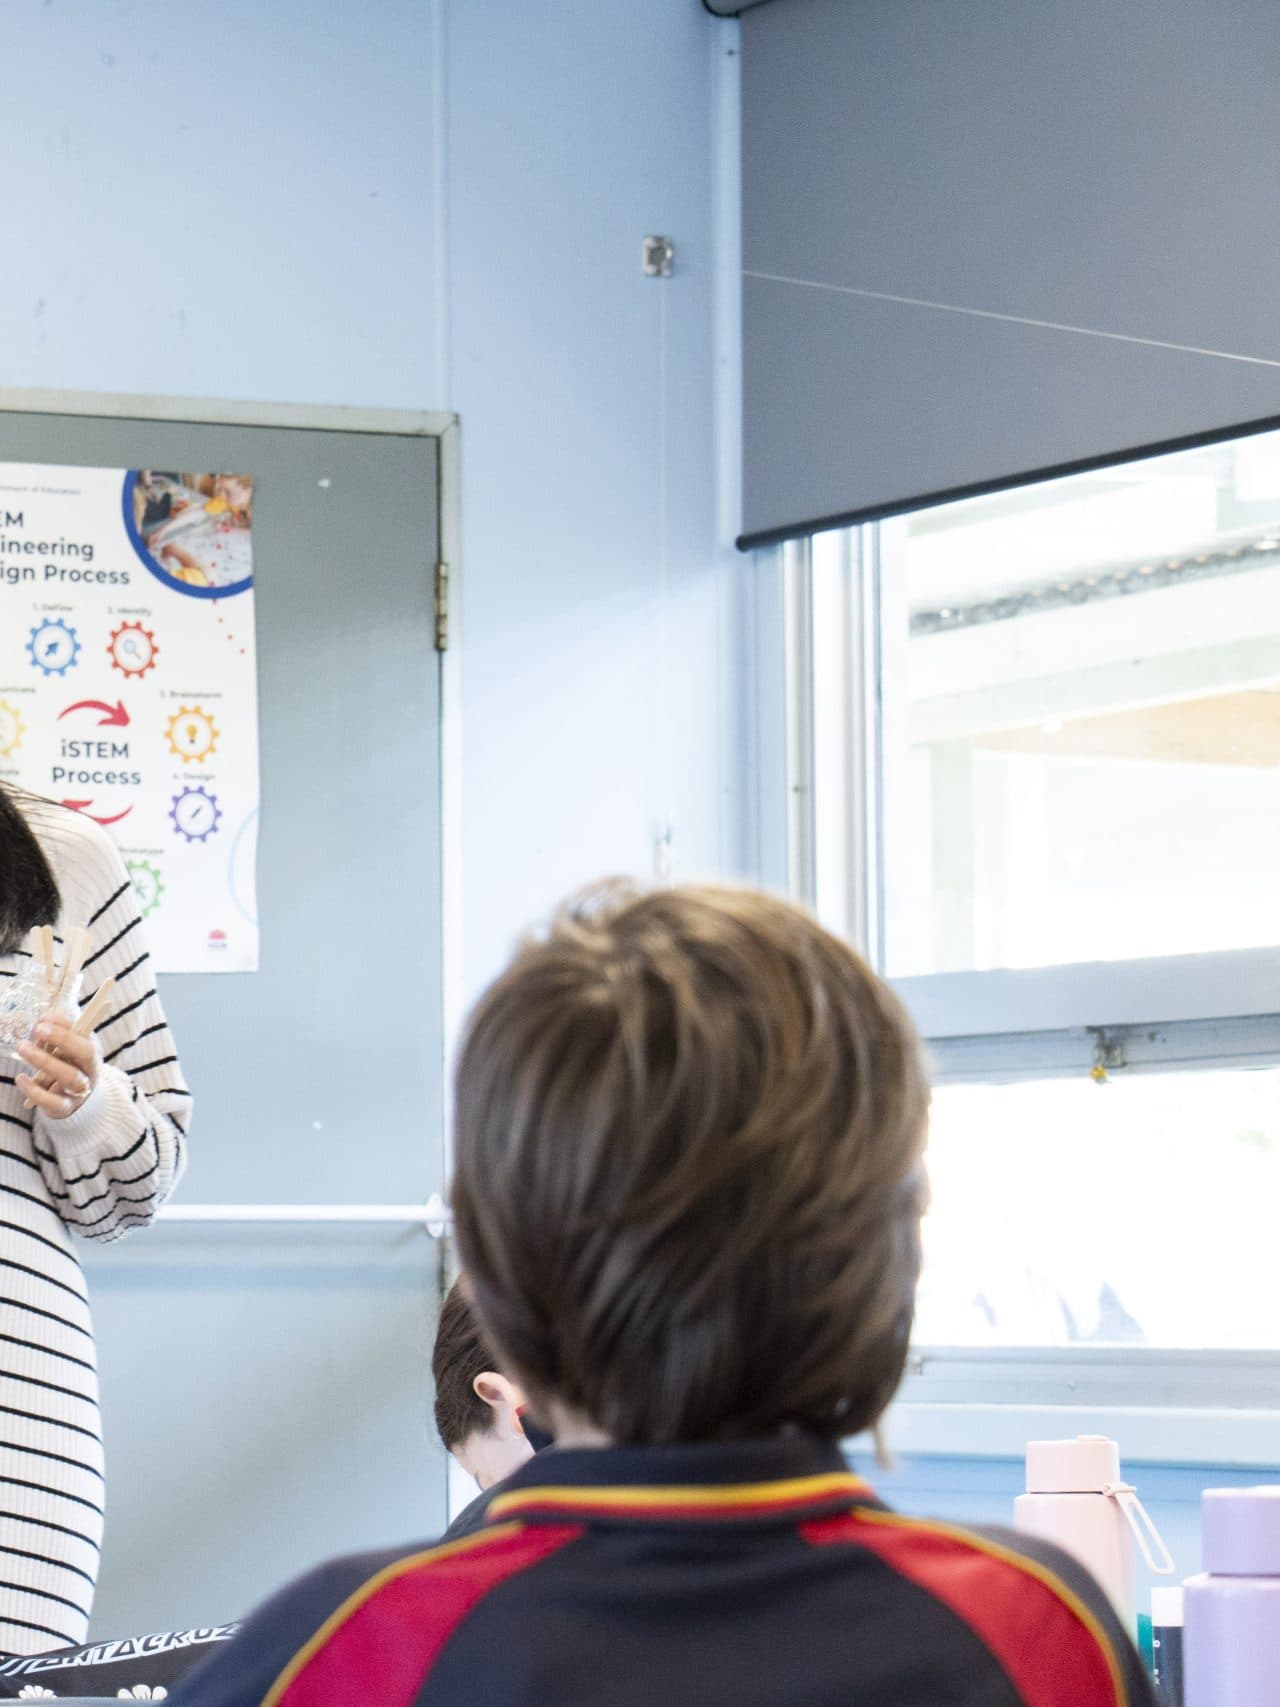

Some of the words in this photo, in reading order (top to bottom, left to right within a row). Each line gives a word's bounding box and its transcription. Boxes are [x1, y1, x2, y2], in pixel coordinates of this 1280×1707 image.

[44, 564, 131, 586] Process
[60, 738, 130, 760] iSTEM
[52, 766, 142, 785] Process
